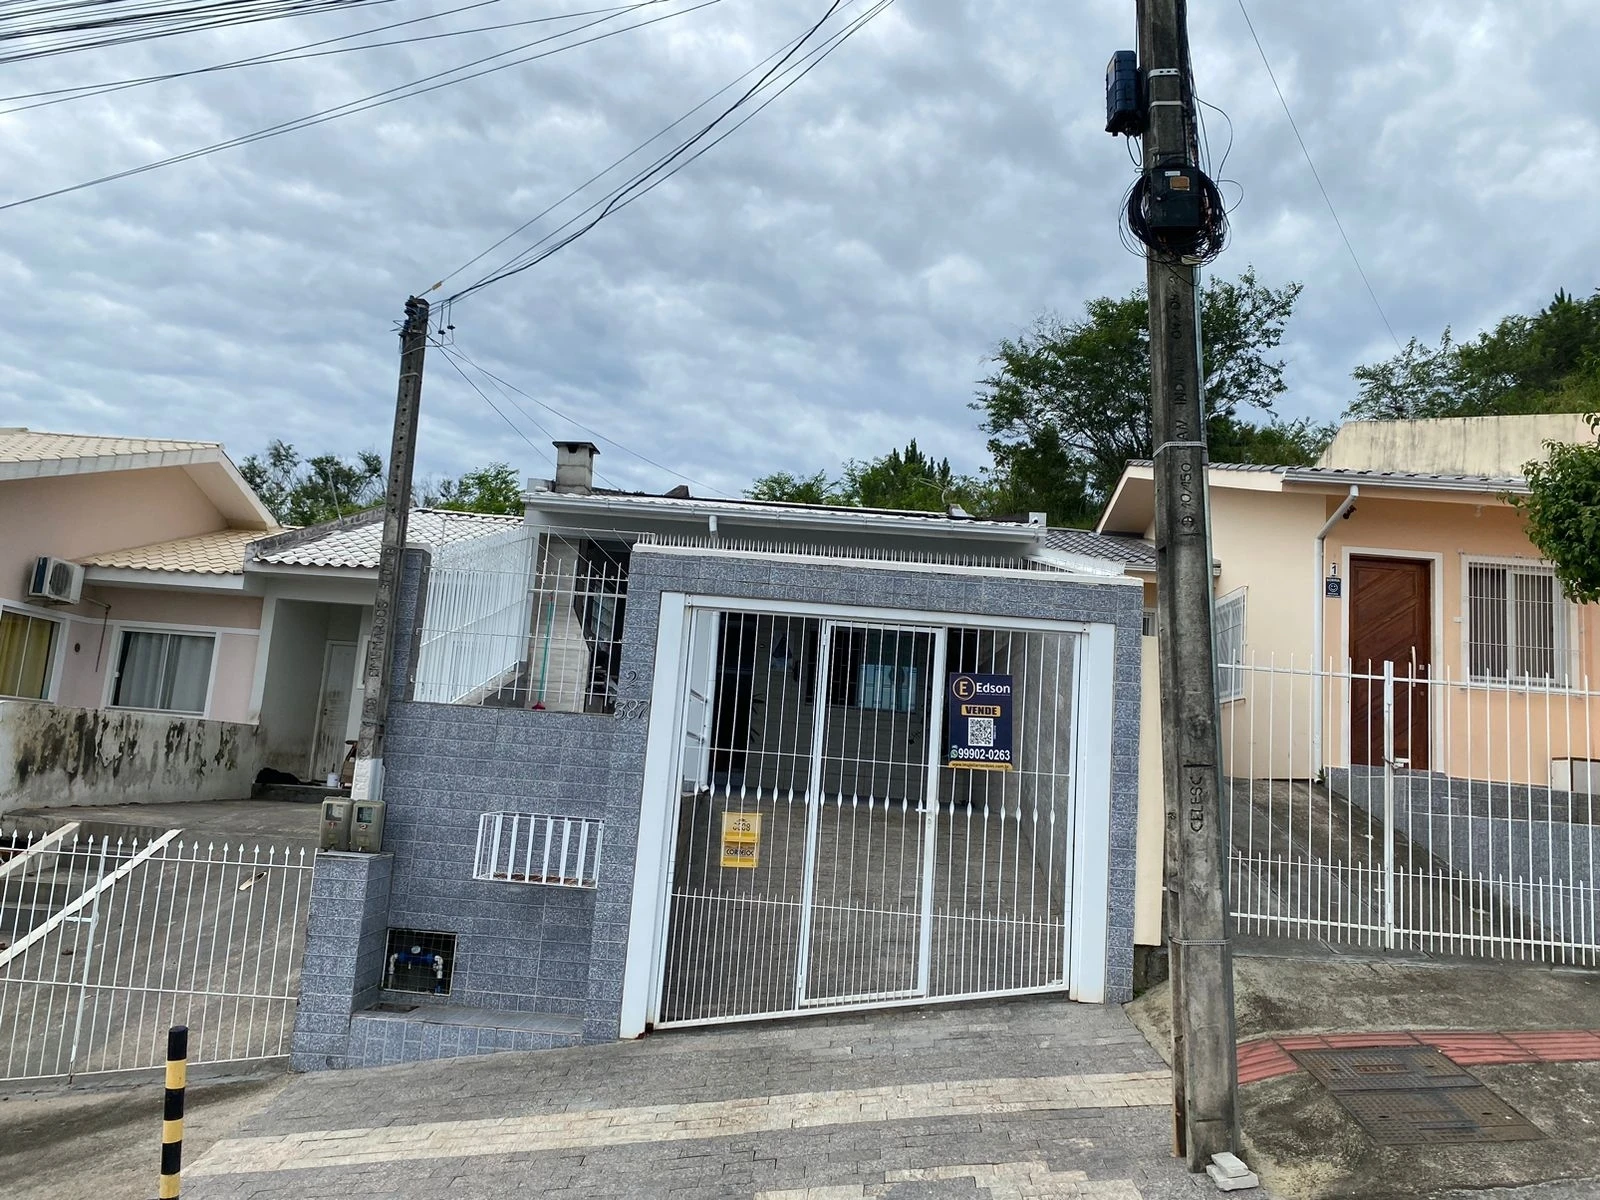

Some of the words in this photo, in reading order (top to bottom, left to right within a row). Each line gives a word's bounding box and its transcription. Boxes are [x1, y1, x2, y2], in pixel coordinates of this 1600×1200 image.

[625, 670, 639, 690] 2
[976, 682, 1011, 694] Edson
[614, 699, 649, 720] 387
[965, 705, 998, 716] VENDE
[958, 747, 1011, 761] 99902-0263
[1189, 776, 1203, 832] CELESC
